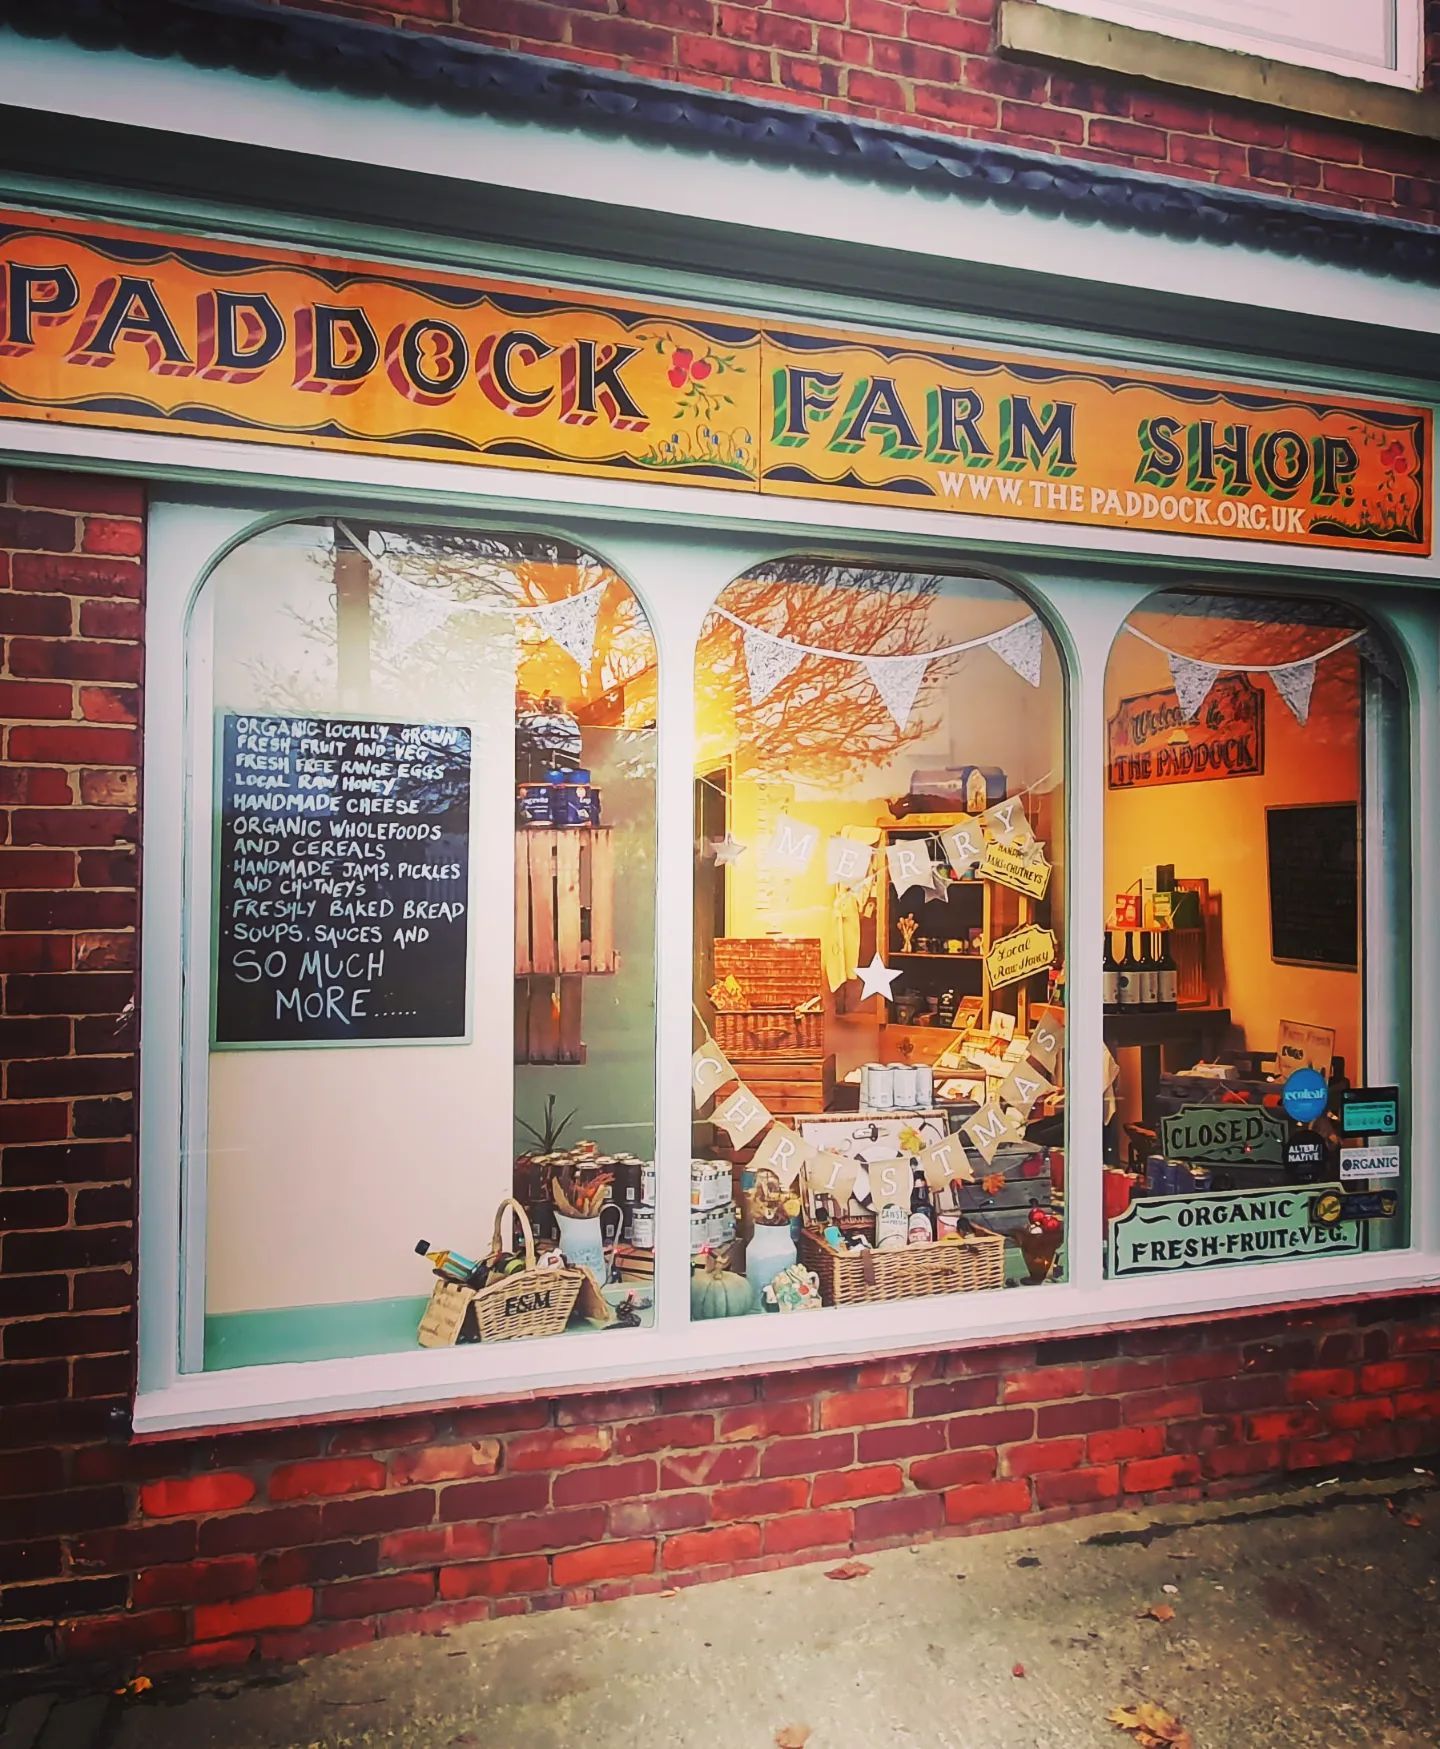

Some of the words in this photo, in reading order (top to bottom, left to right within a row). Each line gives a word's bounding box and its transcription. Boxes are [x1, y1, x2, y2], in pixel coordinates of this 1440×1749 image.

[3, 261, 650, 428] PADDOCK
[776, 364, 1077, 472] FARM
[236, 717, 322, 738] ORGANIC
[326, 722, 389, 741] LOCALLY
[401, 727, 458, 747] GROWN
[1131, 702, 1201, 745] Welcoe
[237, 734, 291, 755] FRESH
[300, 738, 346, 756] FRUIT
[355, 742, 386, 757] AND
[396, 744, 430, 762] VEG
[1115, 751, 1151, 783] THE
[1157, 734, 1254, 778] PADDOCK
[236, 753, 289, 774] FRESH
[296, 758, 337, 773] FREE
[341, 760, 394, 778] RANGE
[398, 764, 445, 780] EGGS
[235, 773, 291, 789] LOCAL
[298, 774, 339, 790] RAW
[342, 776, 397, 796] HONEY
[234, 793, 343, 812] HANDMADE
[346, 798, 420, 815] CHEESE
[233, 816, 322, 838] ORGANIC
[329, 819, 442, 841] WHOLEFOODS
[234, 838, 280, 855] AND
[292, 841, 386, 860] CEREALS
[233, 859, 334, 879] HANDMADE
[398, 863, 461, 881] PICKLES
[233, 877, 272, 897] AND
[232, 899, 317, 922] FRESHLY
[329, 900, 394, 924] BAKED
[402, 901, 465, 923] BREAD
[314, 924, 383, 949] SAUCES
[393, 926, 430, 949] AND
[232, 949, 287, 983] SO
[298, 949, 384, 988] MUCH
[1288, 1152, 1319, 1162] NATIVE
[1342, 1157, 1399, 1171] ORGANIC
[1177, 1200, 1294, 1227] ORGANIC
